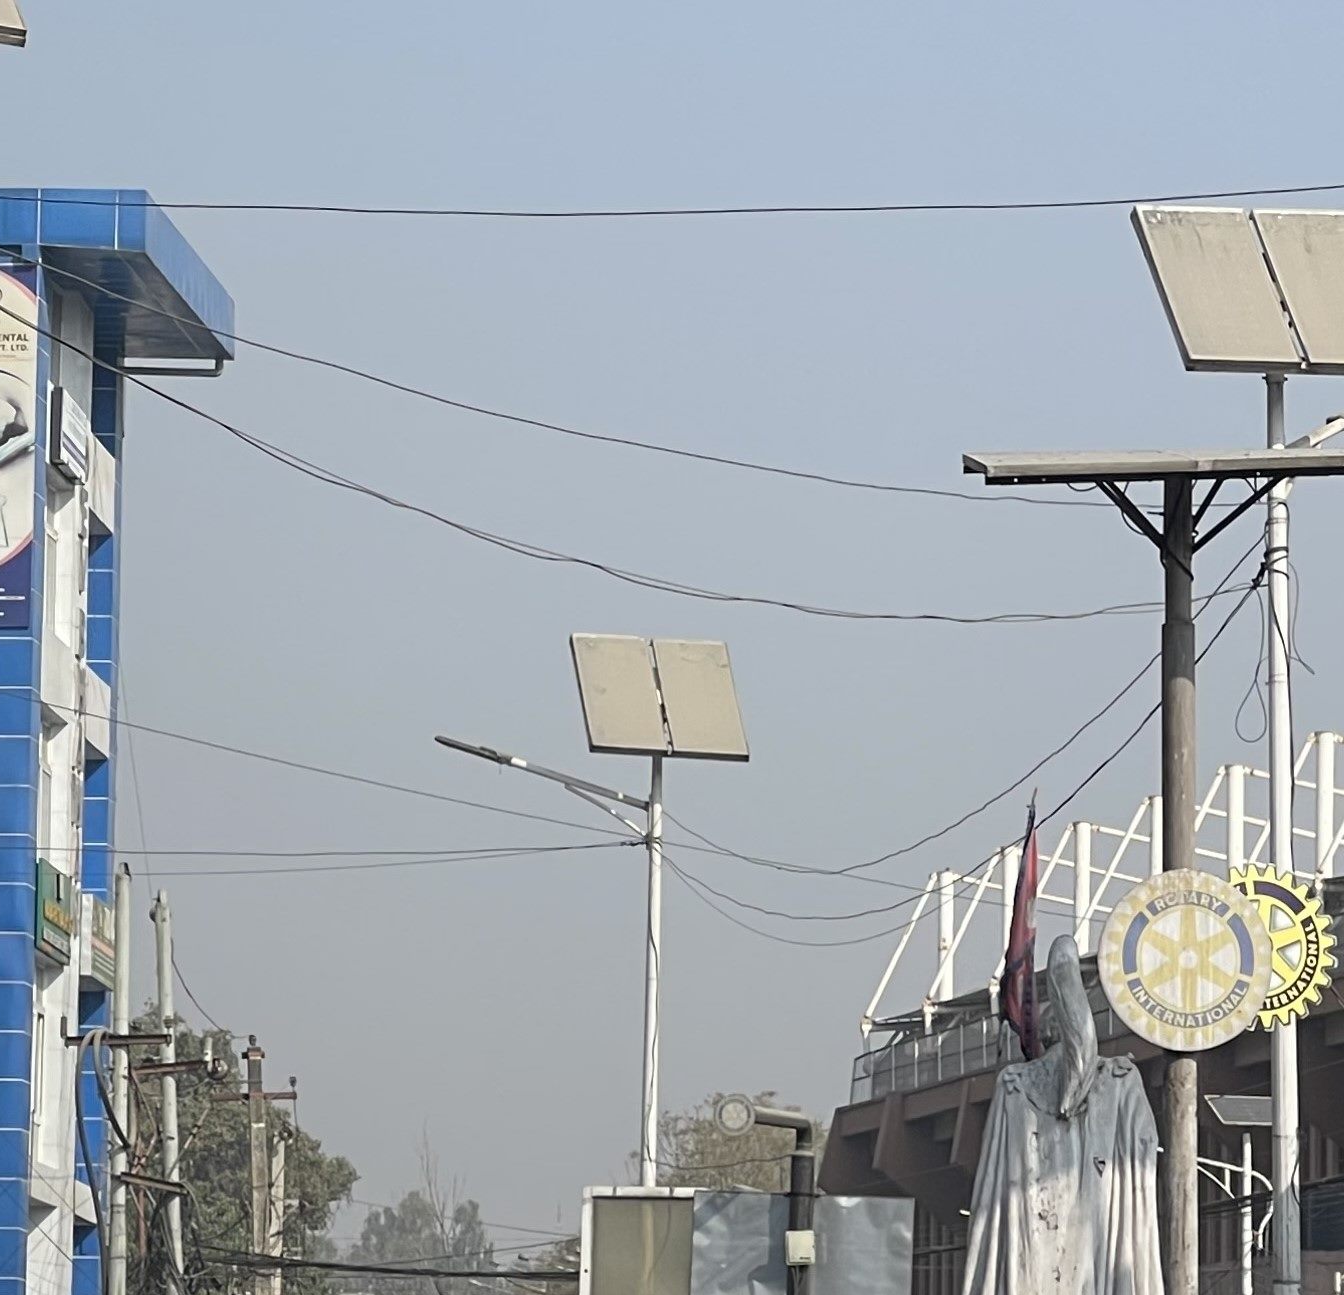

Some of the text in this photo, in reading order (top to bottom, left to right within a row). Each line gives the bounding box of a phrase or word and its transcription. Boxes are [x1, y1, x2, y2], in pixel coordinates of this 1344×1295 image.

[1155, 890, 1222, 912] ROTARY
[1264, 922, 1318, 1010] TERNATIONAL
[1131, 984, 1248, 1029] INTERNATIONAL
